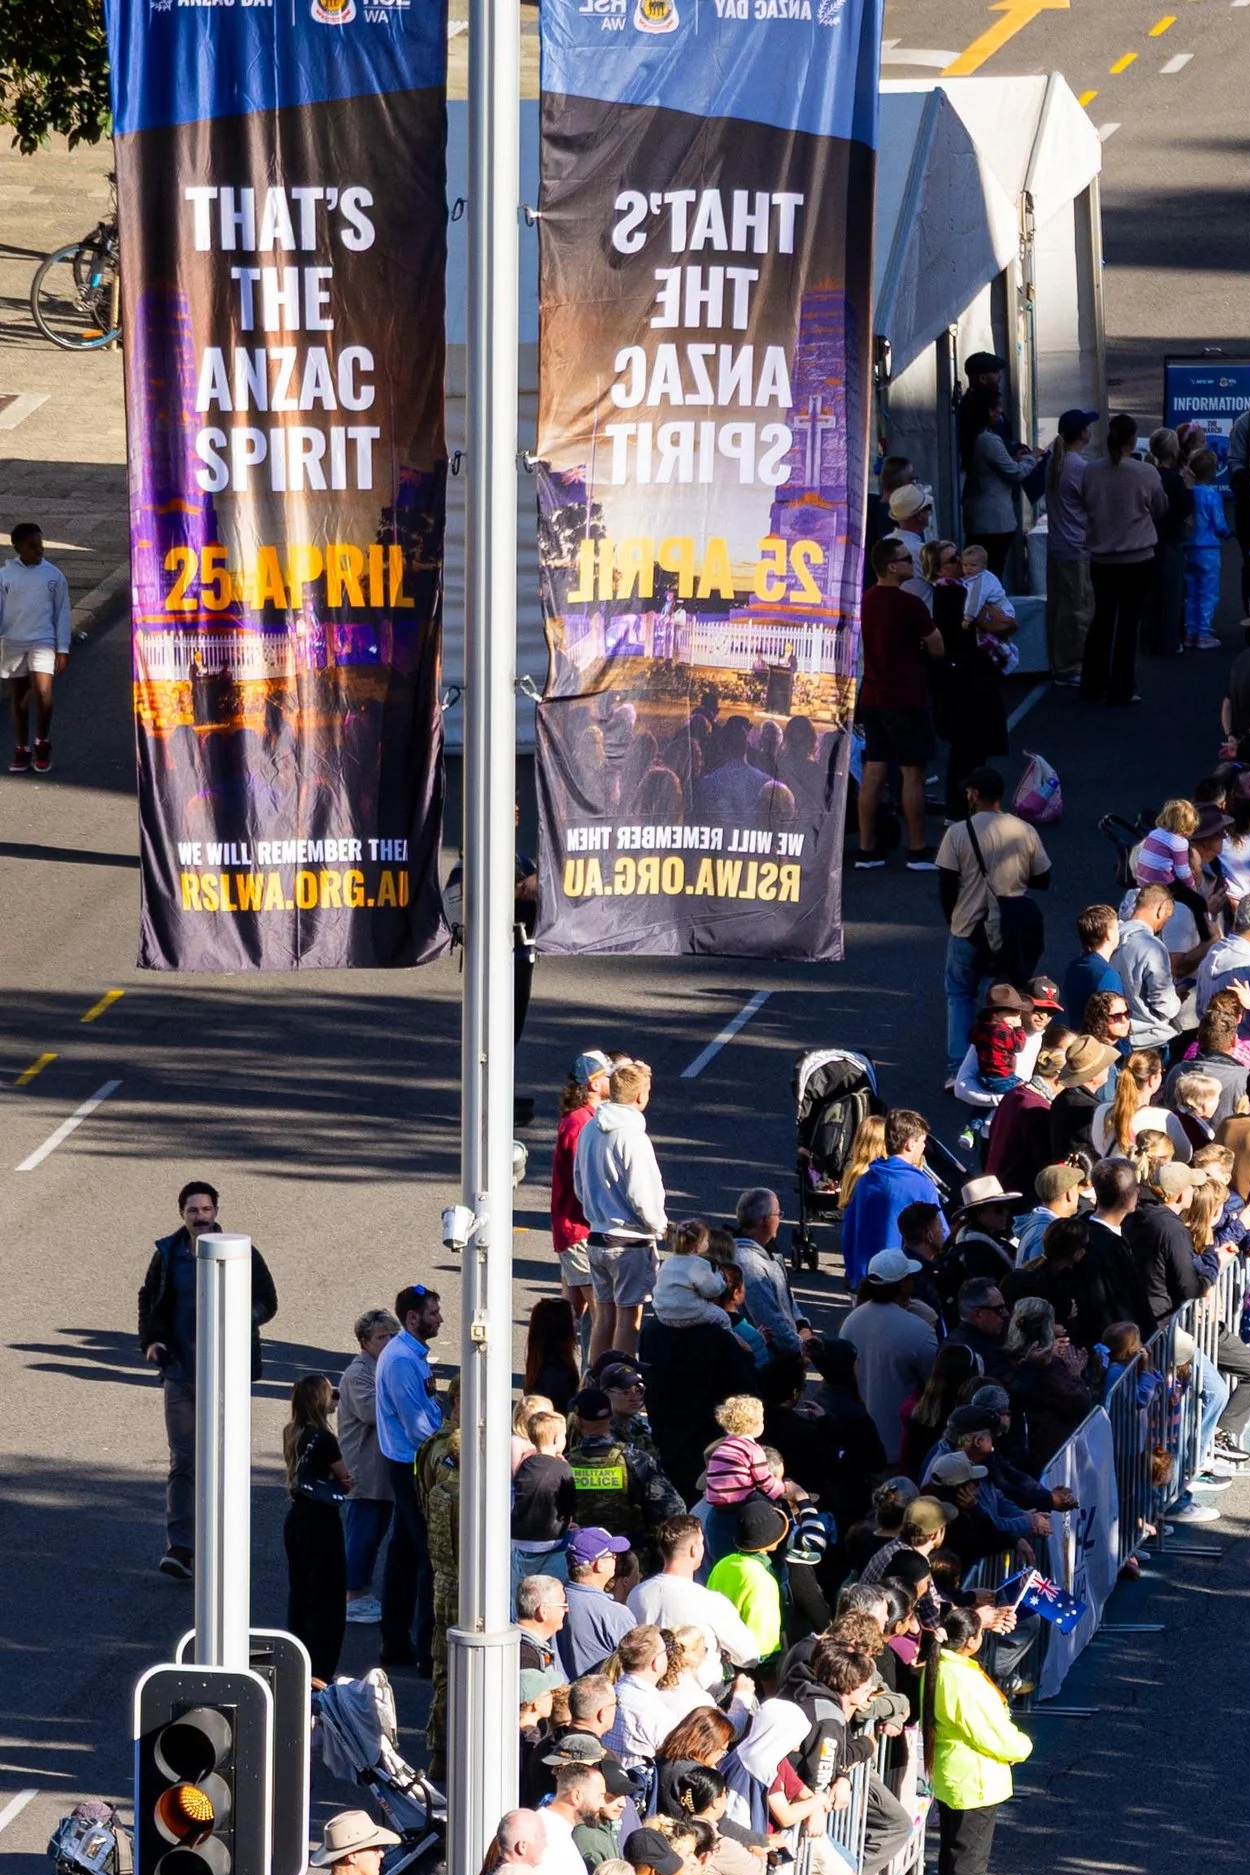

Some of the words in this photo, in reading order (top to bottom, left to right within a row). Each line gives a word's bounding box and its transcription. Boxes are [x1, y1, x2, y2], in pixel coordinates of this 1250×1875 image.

[364, 10, 388, 24] WA
[184, 186, 375, 251] THAT'S
[230, 267, 334, 332] THE
[194, 346, 376, 412] ANZAC
[195, 426, 381, 493] SPIRIT
[164, 545, 231, 611] 25
[253, 544, 415, 610] APRIL
[178, 840, 203, 866] WE
[206, 840, 252, 865] WILL
[257, 838, 362, 865] REMEMBER
[181, 870, 409, 912] RSLWA.ORG.AU
[575, 1477, 619, 1486] POLICE
